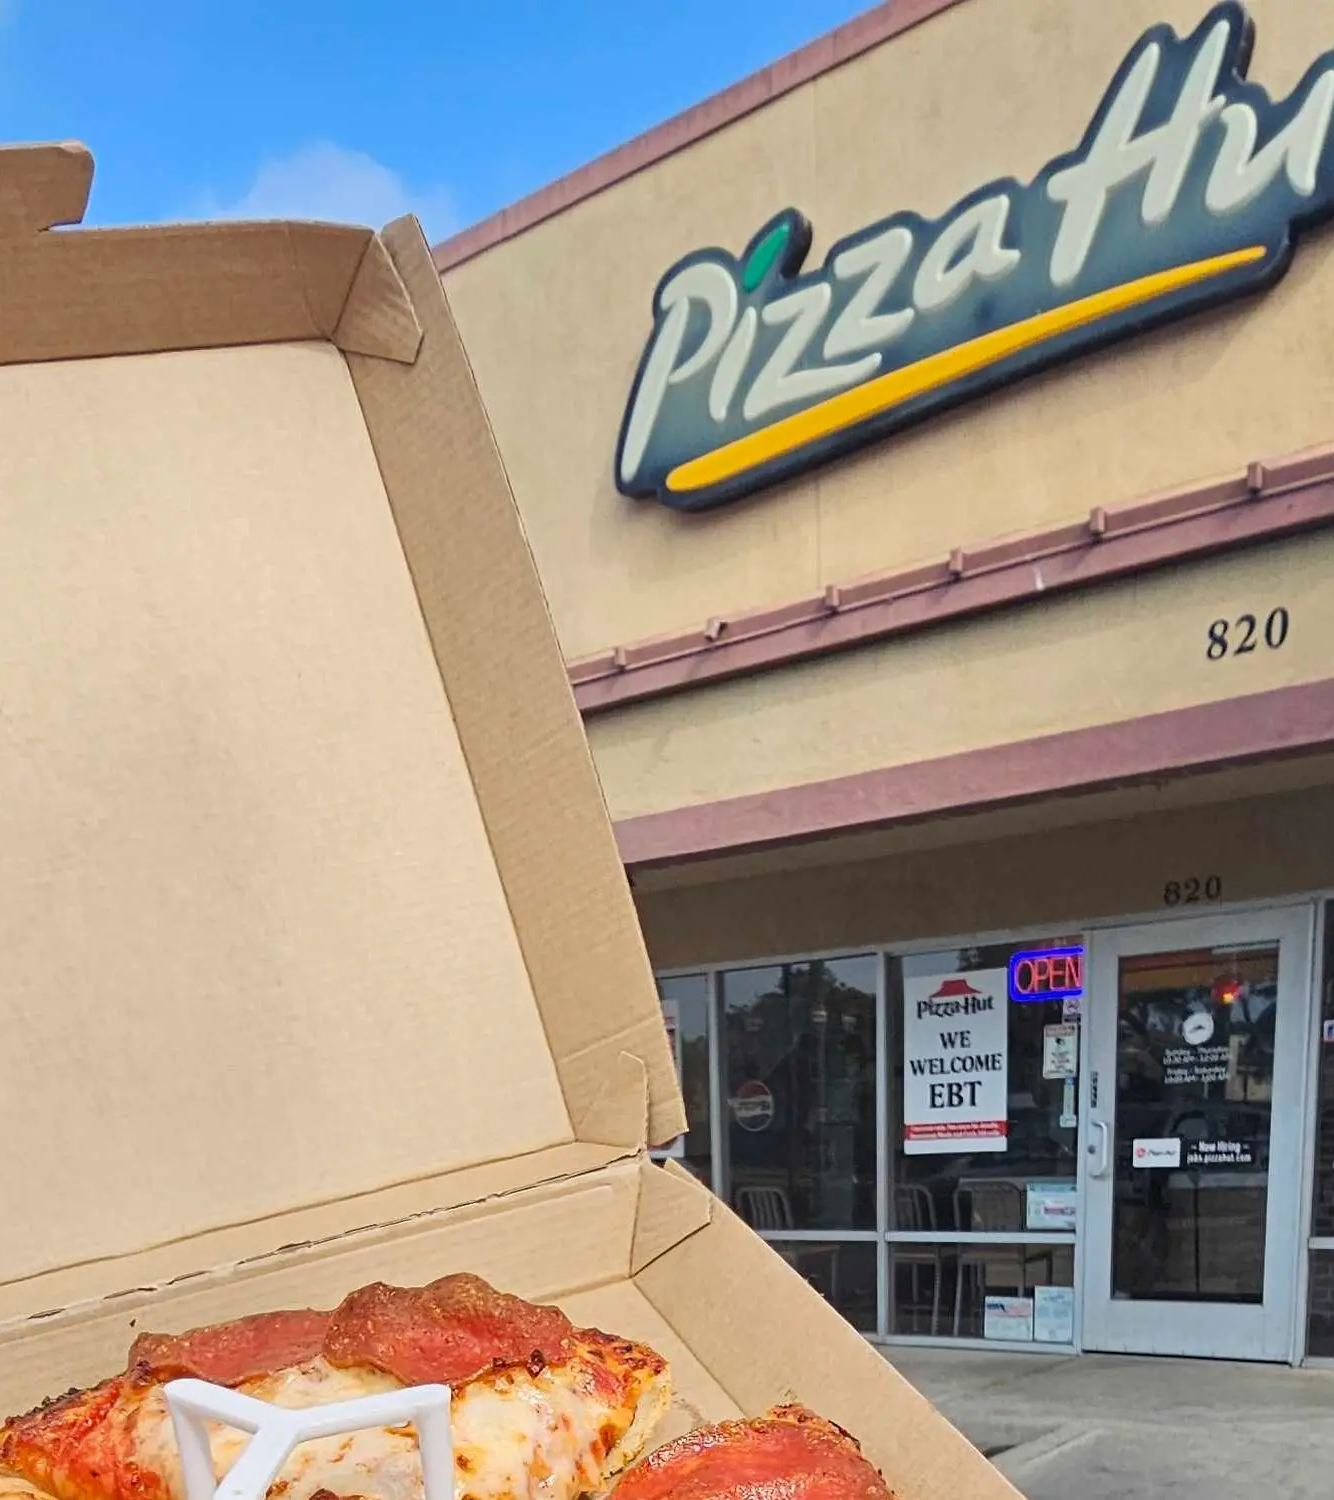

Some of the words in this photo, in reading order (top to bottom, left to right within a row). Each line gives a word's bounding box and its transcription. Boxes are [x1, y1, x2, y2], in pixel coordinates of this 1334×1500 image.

[620, 194, 1021, 483] Pizza
[1206, 606, 1290, 661] 820
[1163, 875, 1222, 906] 820
[1014, 955, 1083, 994] OPEN
[917, 998, 962, 1019] Pizza
[961, 995, 995, 1016] Hut
[939, 1030, 971, 1049] WE
[909, 1053, 1003, 1076] WELCOME
[929, 1081, 982, 1109] EBT
[1198, 1140, 1216, 1152] Now
[1217, 1140, 1241, 1154] Hiring
